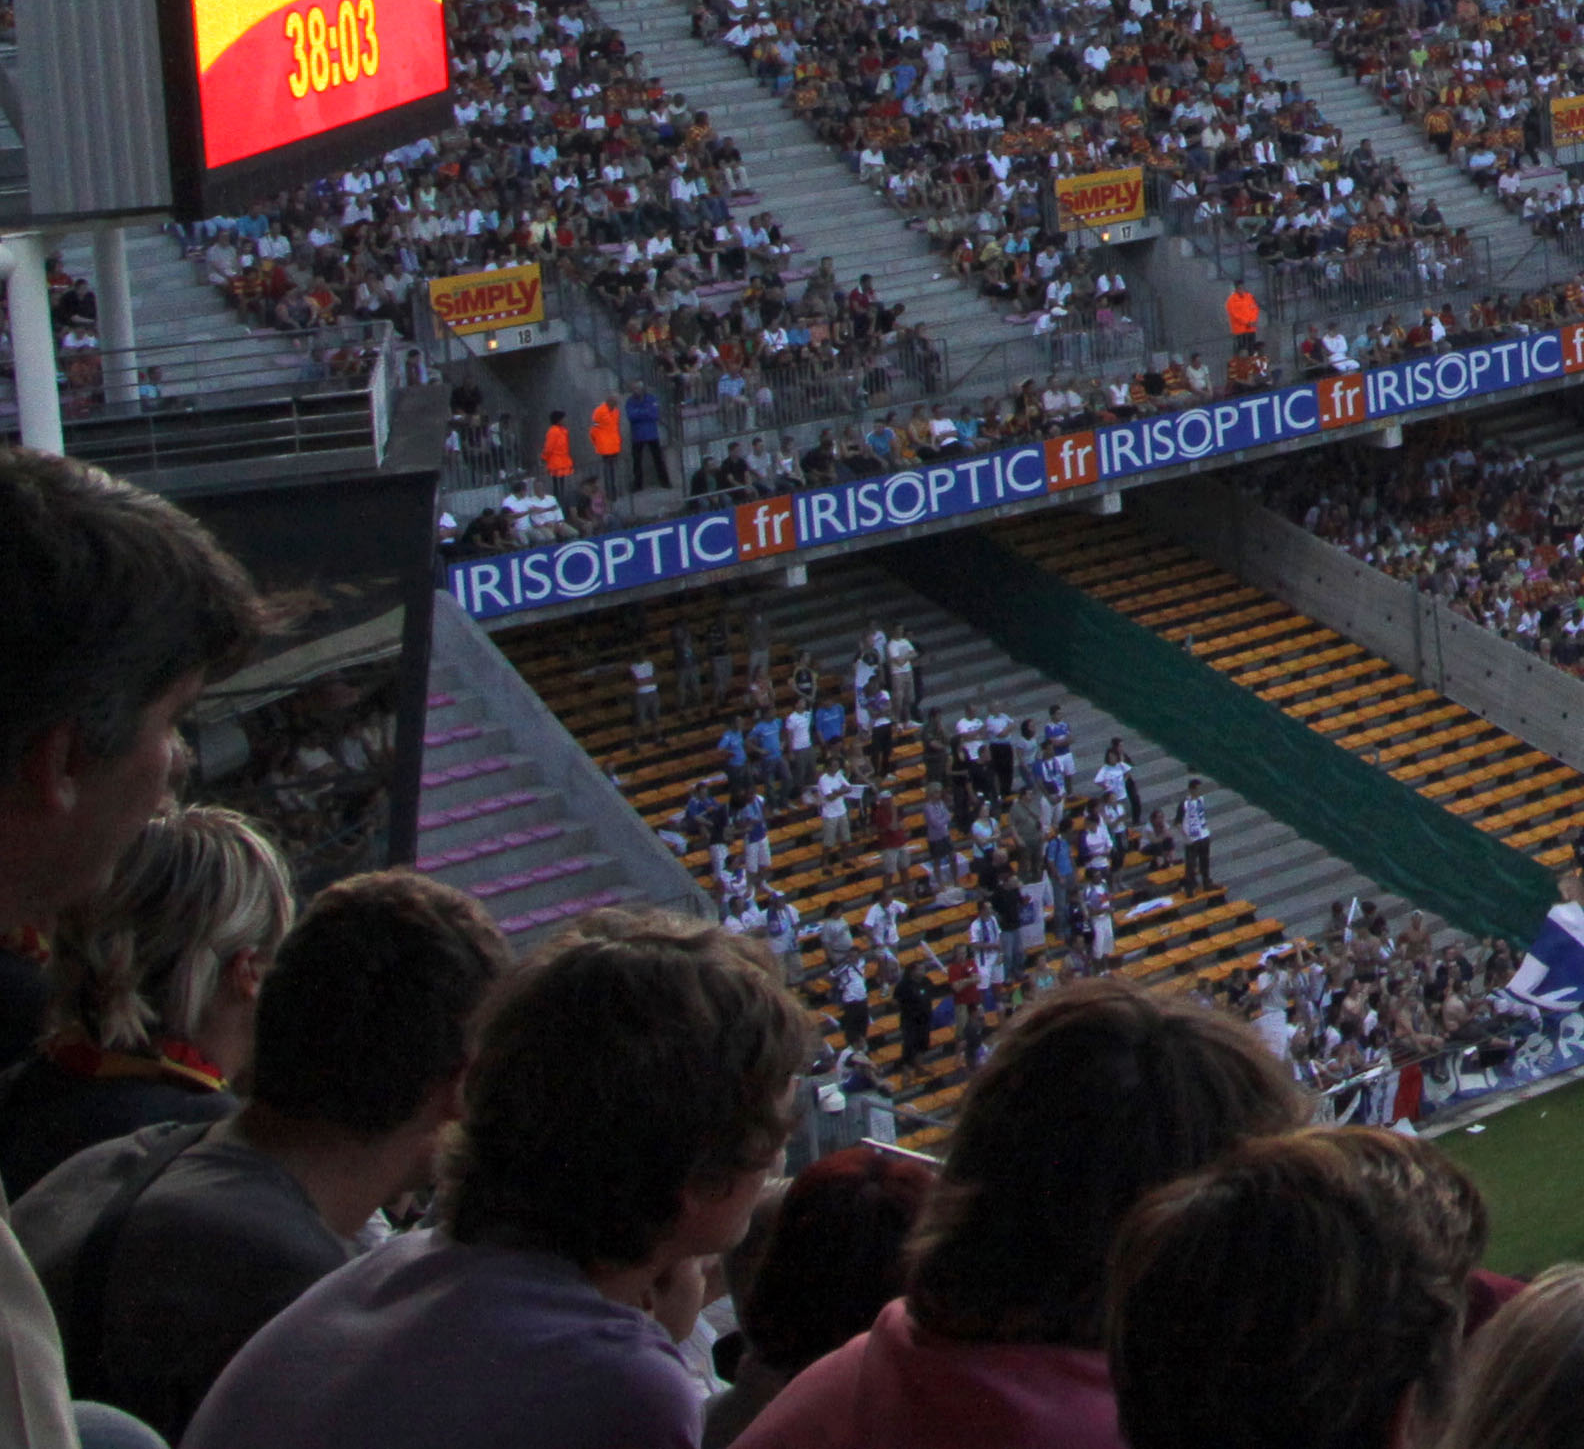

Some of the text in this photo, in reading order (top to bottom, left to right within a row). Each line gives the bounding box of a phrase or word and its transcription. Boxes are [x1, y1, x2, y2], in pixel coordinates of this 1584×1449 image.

[518, 329, 532, 344] 18
[1100, 377, 1361, 476] IRISOPTIC.fr
[798, 436, 1094, 542] IRISOPTIC.fr
[452, 504, 793, 617] IRISOPTIC.fr
